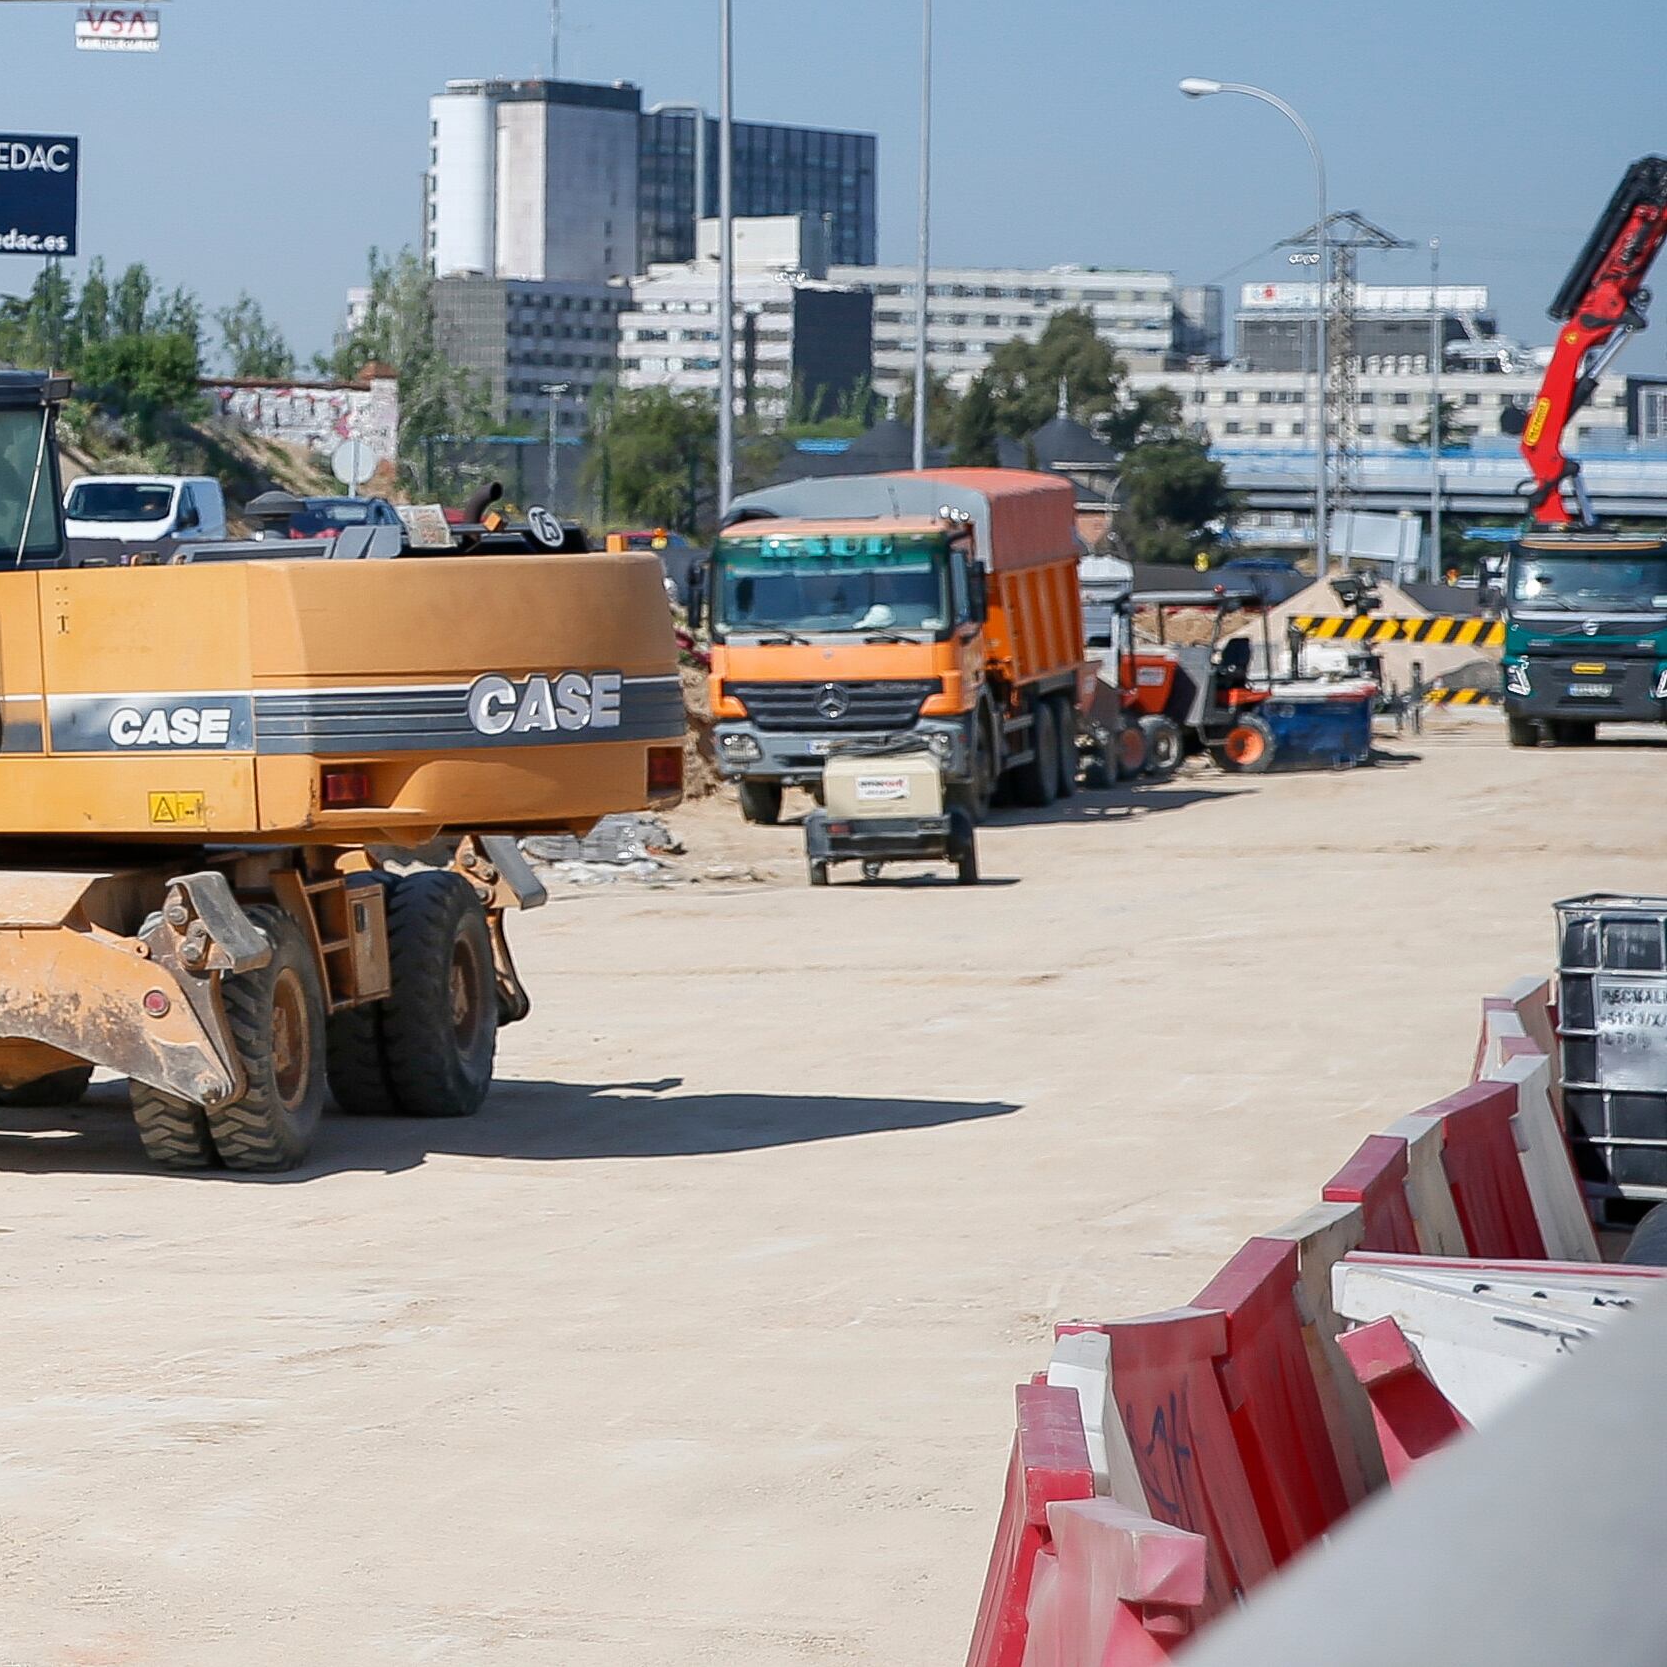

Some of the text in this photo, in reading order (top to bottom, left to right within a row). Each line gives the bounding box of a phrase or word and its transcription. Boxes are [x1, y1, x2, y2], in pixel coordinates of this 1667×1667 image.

[85, 9, 147, 34] VSA
[468, 671, 623, 735] CASE
[108, 707, 231, 746] CASE
